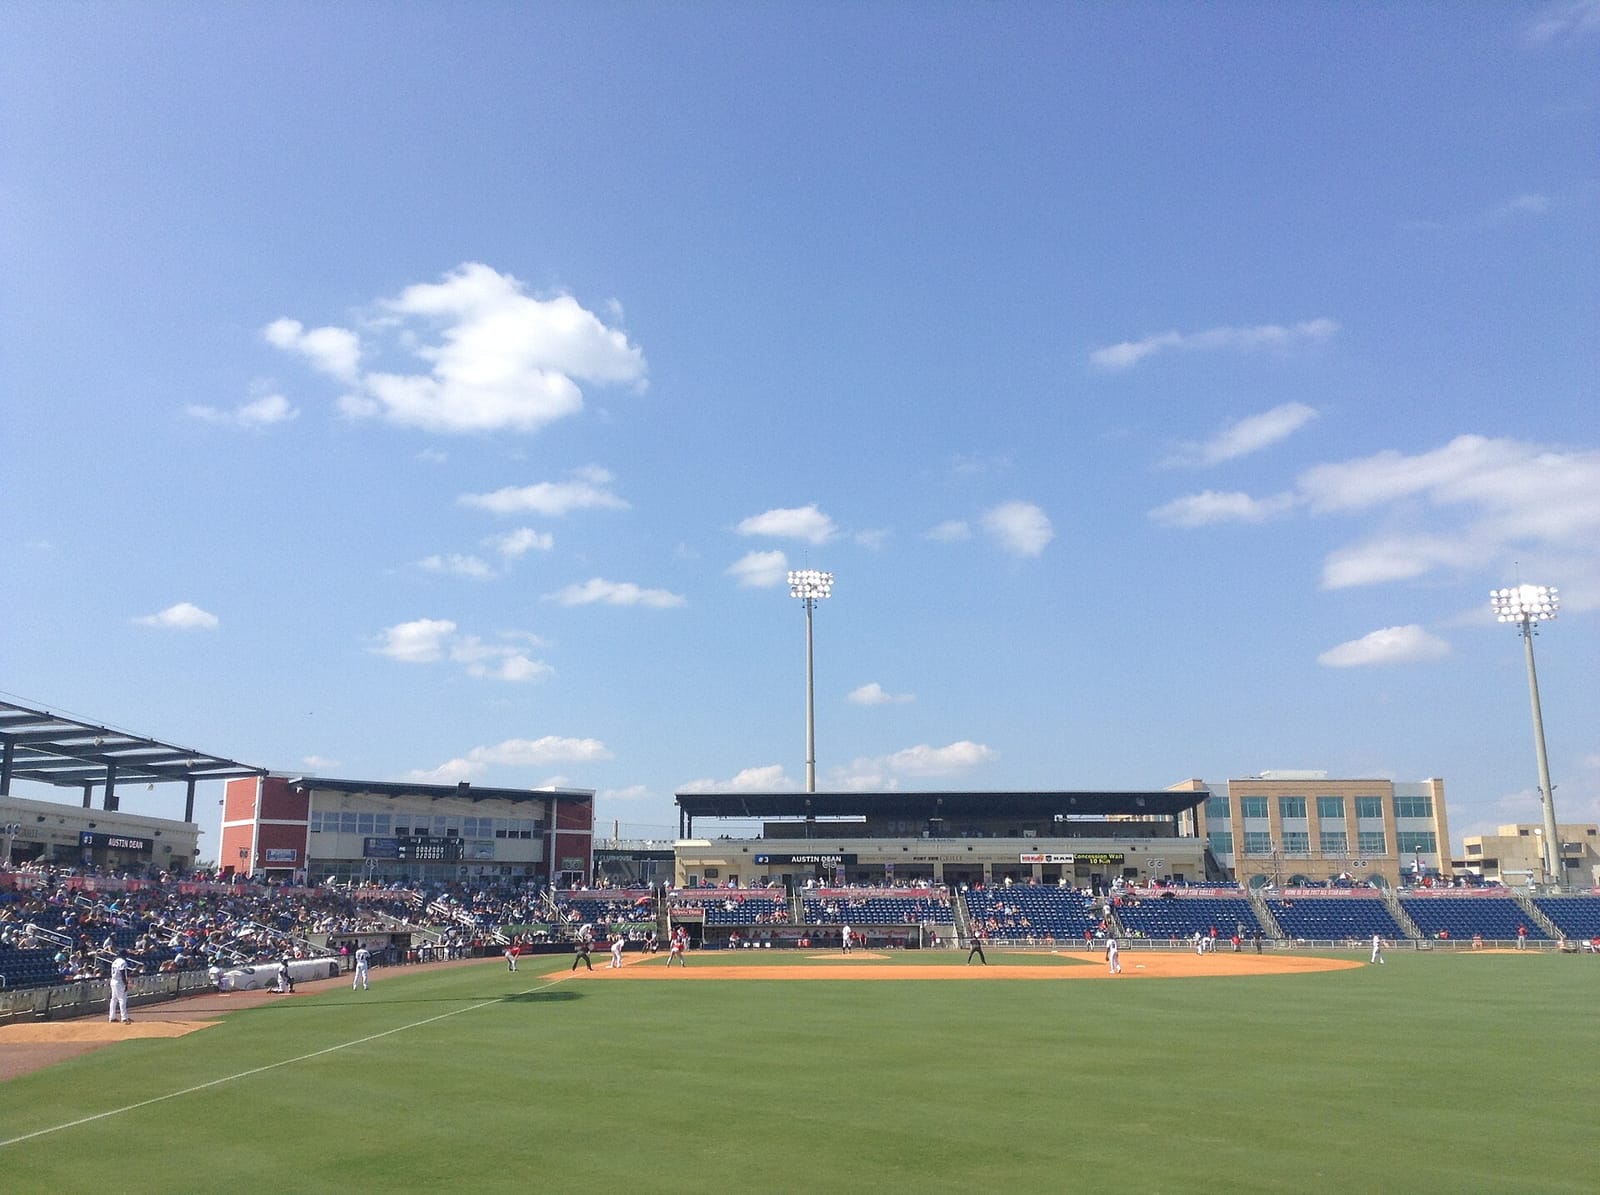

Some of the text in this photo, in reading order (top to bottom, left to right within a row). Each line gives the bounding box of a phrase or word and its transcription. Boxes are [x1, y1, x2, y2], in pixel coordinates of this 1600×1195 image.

[84, 836, 143, 849] #3 AUSTIN DEAN
[820, 855, 842, 863] DEAN
